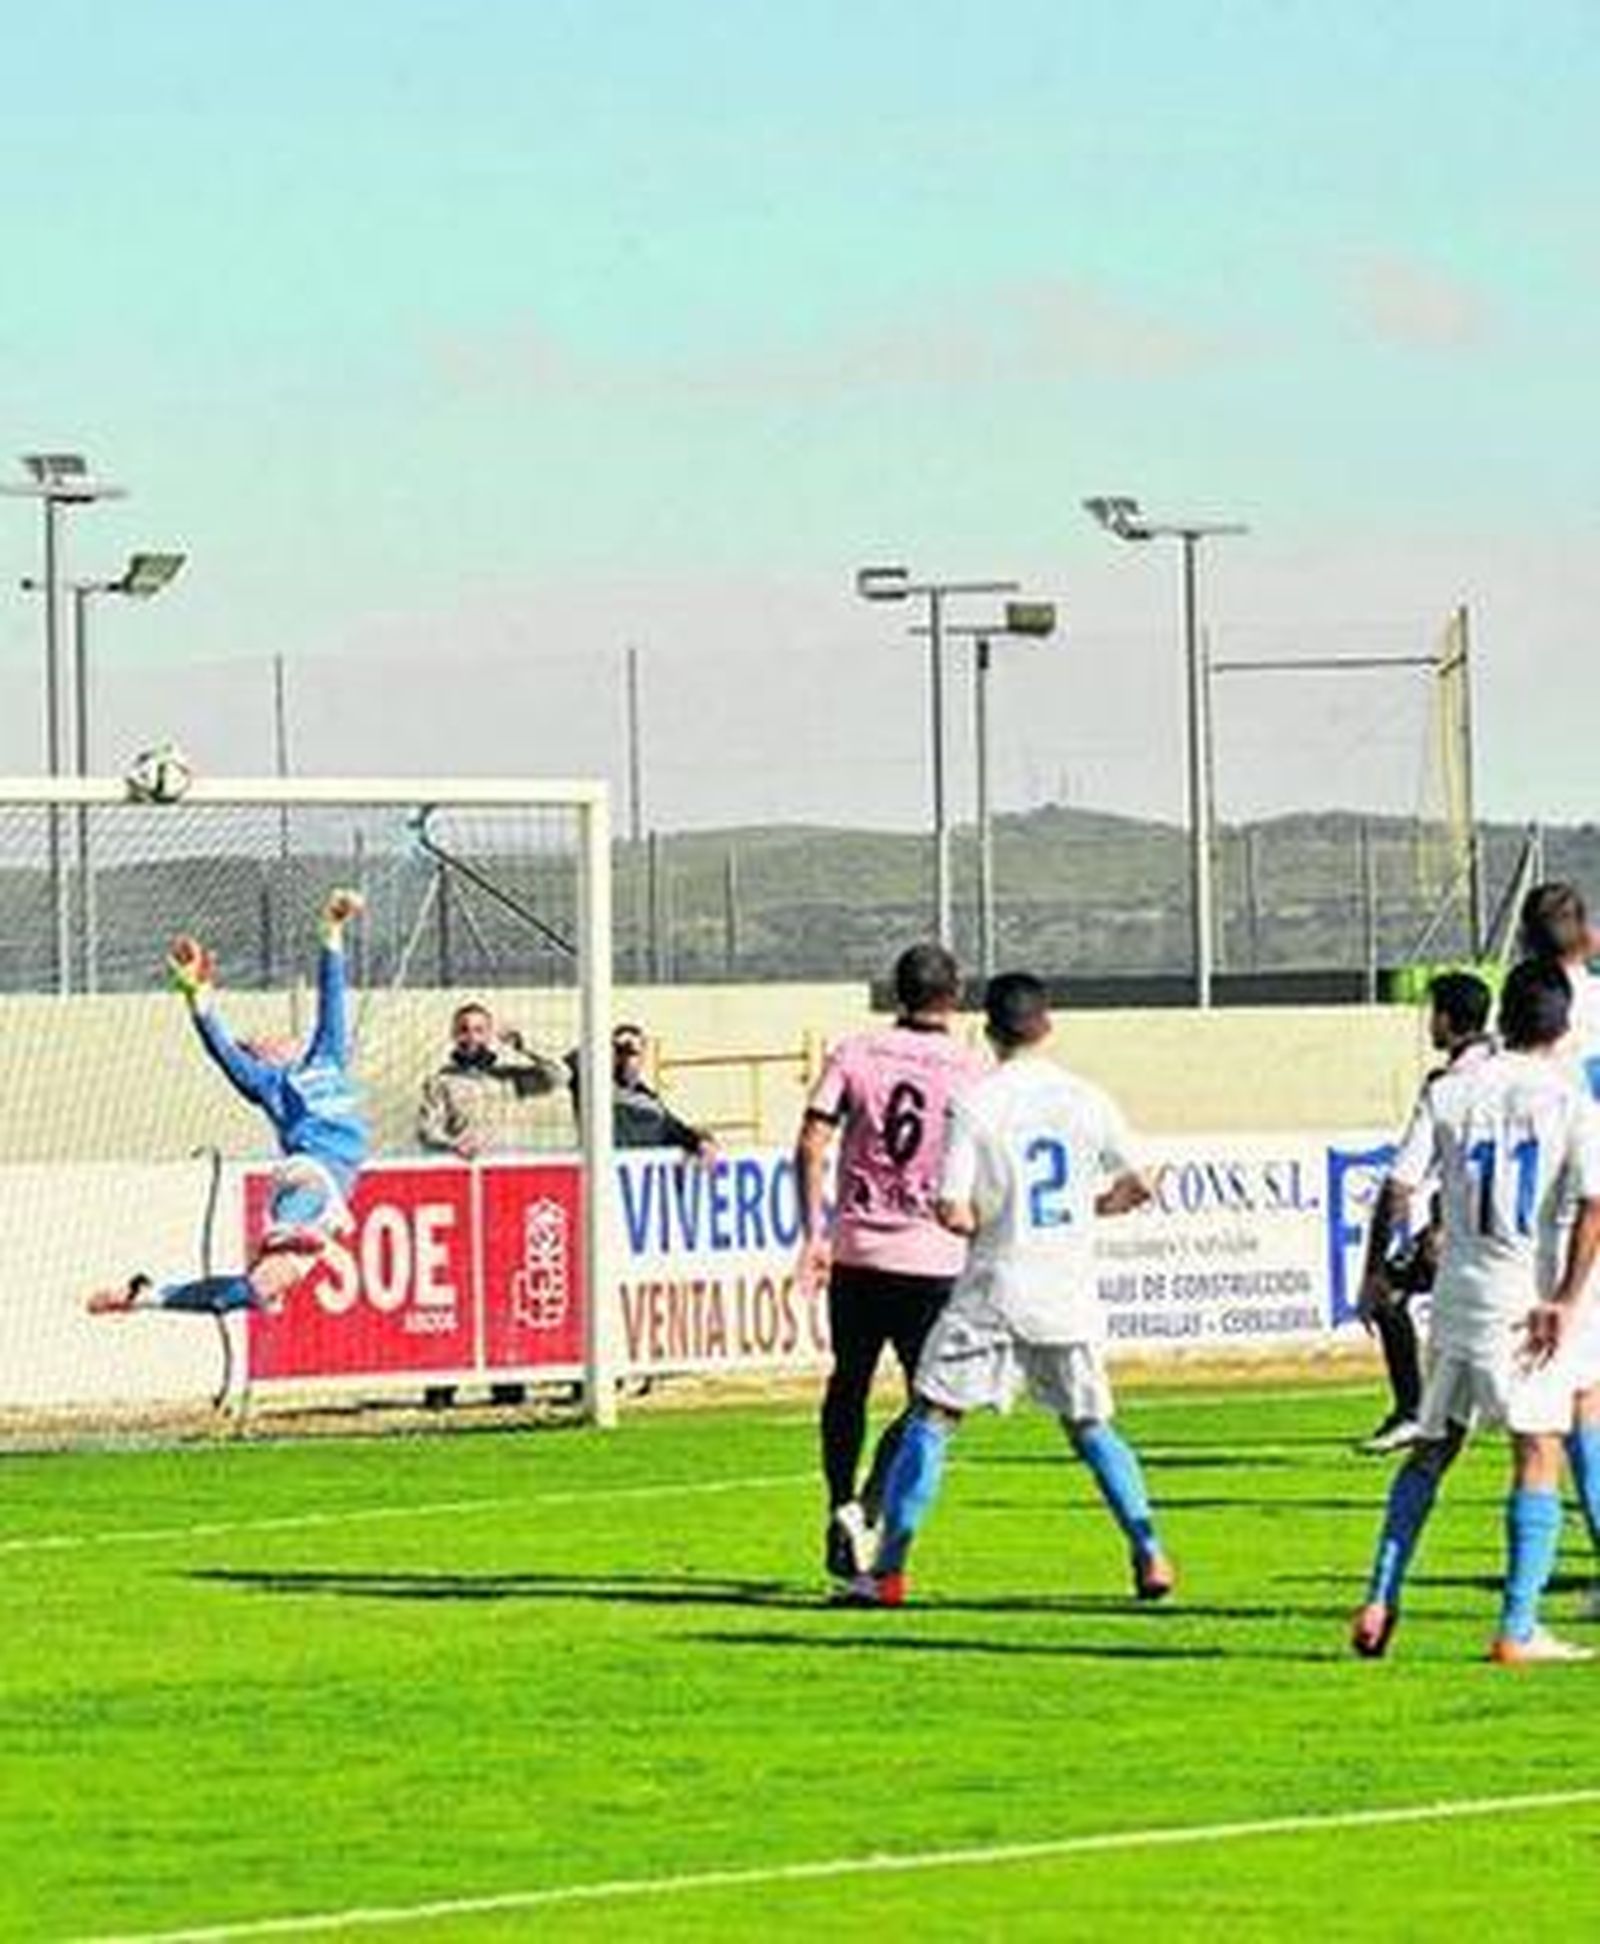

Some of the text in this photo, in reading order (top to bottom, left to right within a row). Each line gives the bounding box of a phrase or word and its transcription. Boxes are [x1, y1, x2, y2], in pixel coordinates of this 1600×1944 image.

[886, 1081, 925, 1163] 6
[1026, 1137, 1072, 1227] 2
[1471, 1141, 1539, 1237] 11
[264, 1202, 457, 1318] SOE
[1142, 1274, 1166, 1301] DE
[619, 1280, 727, 1362] VENTA
[737, 1275, 799, 1355] LOS
